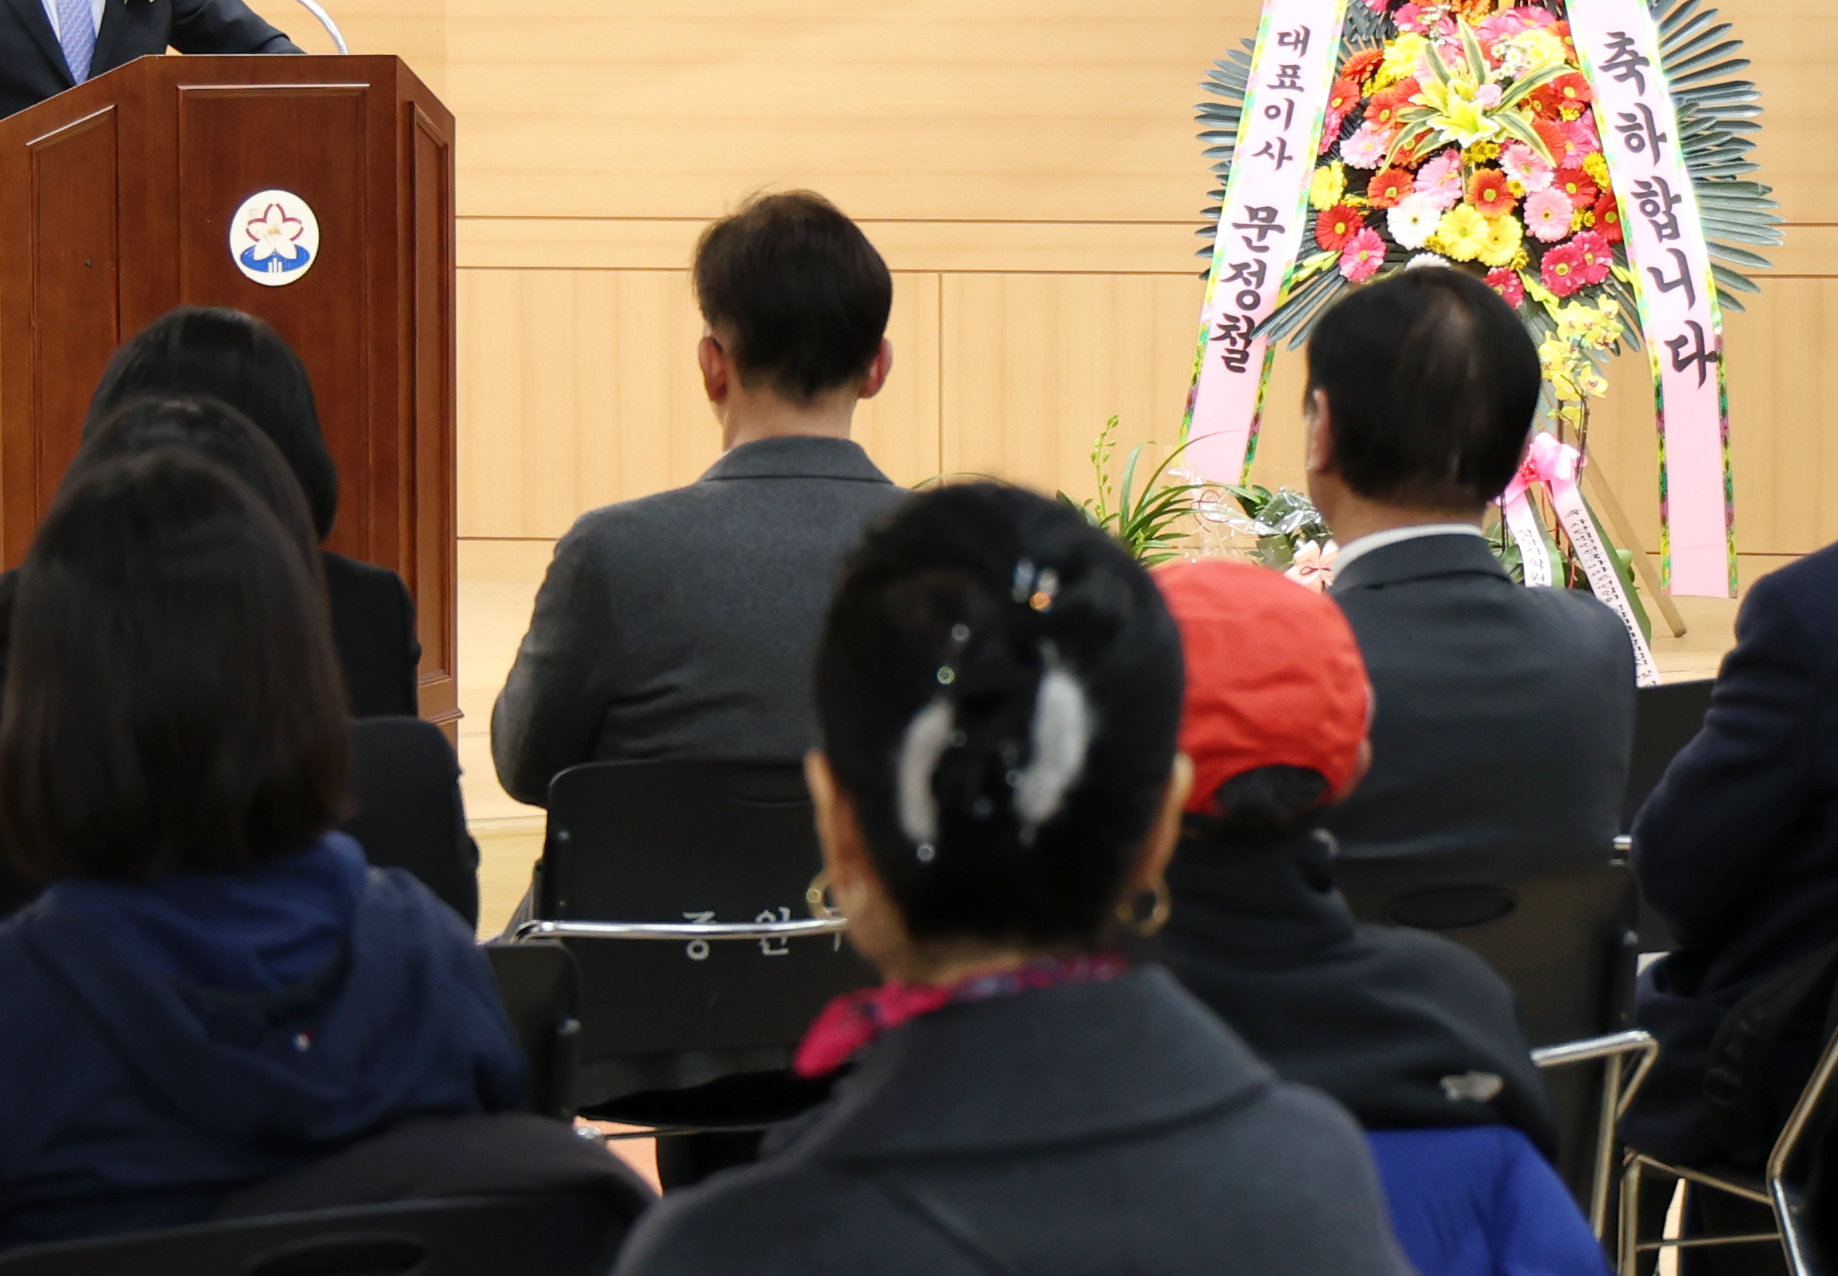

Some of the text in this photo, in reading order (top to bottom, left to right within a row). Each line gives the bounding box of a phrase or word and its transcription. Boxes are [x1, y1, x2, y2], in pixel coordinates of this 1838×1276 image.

[1250, 25, 1313, 173] 대표이사
[1209, 204, 1287, 375] 문정철
[1596, 31, 1720, 391] 축하합니다
